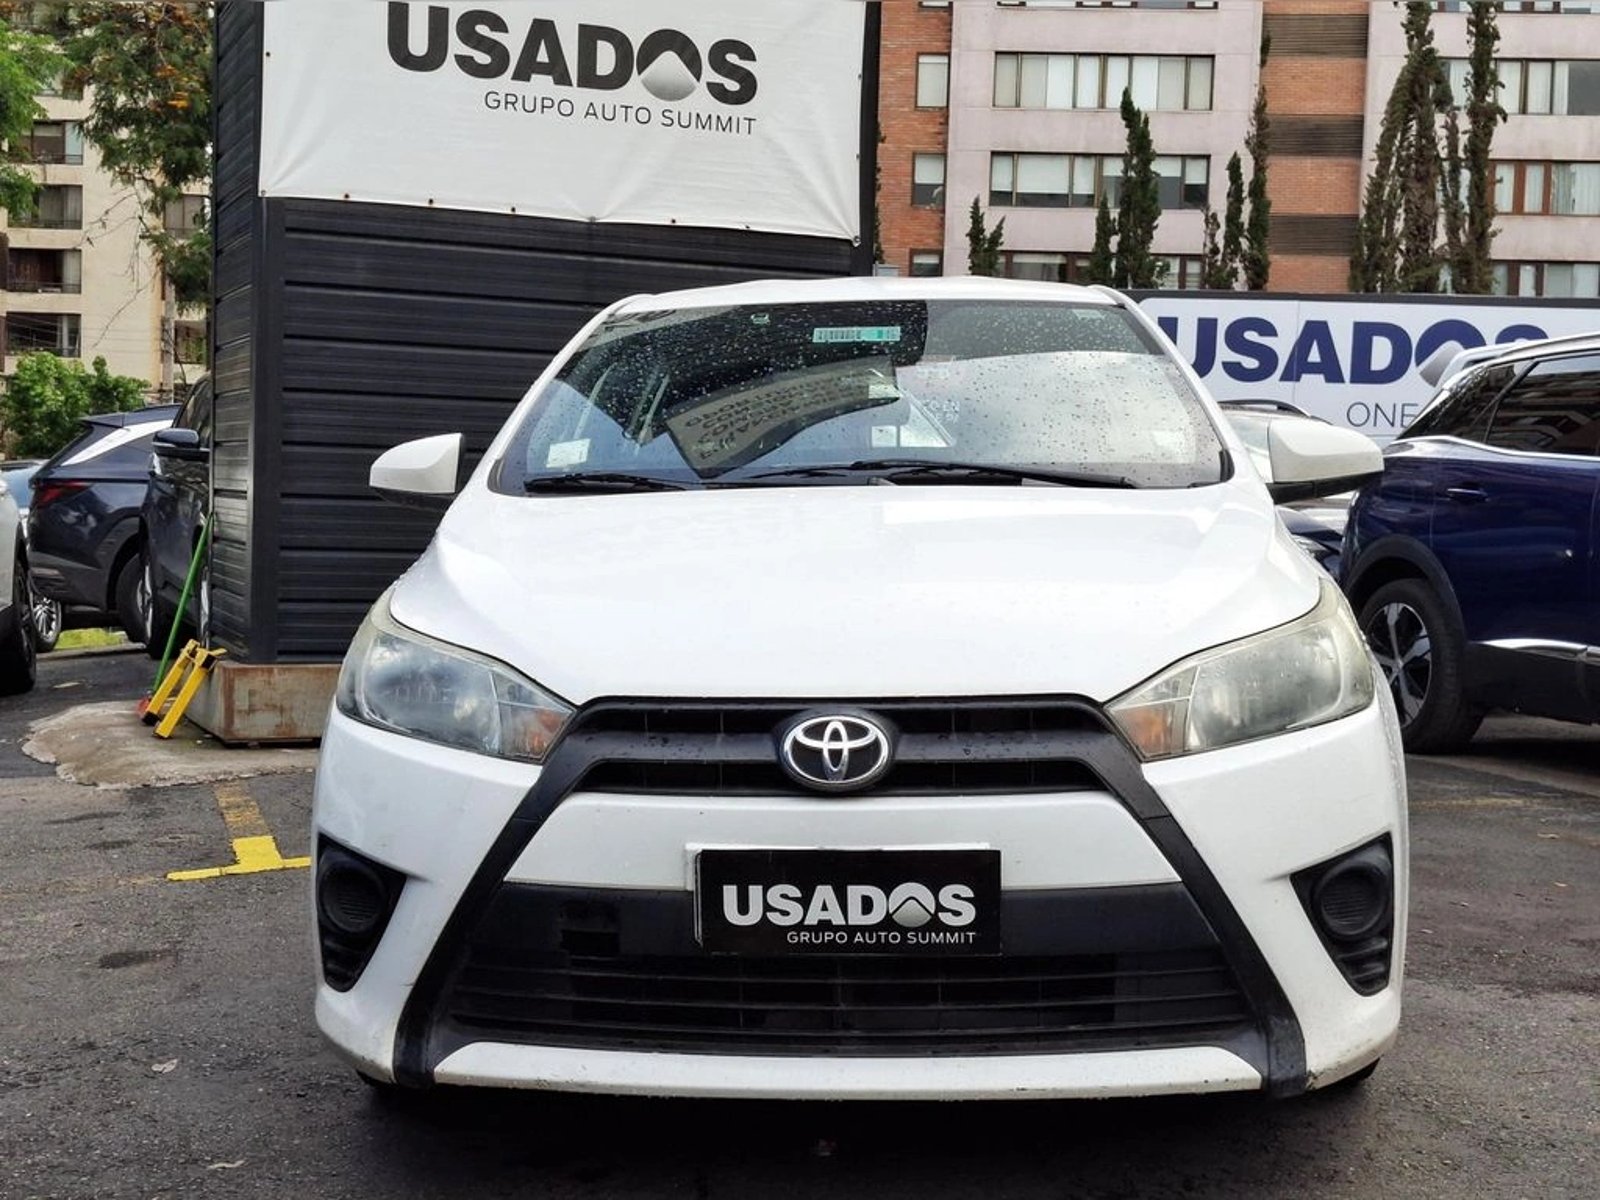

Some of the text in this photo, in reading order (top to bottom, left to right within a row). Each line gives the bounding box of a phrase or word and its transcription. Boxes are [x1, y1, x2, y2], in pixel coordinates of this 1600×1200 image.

[387, 1, 758, 106] USADOS
[484, 91, 757, 135] GRUPO AUTO SUMMIT
[1346, 401, 1419, 429] ONE
[722, 882, 976, 927] USADOS
[786, 931, 976, 944] GRUPO AUTO SUMMIT
